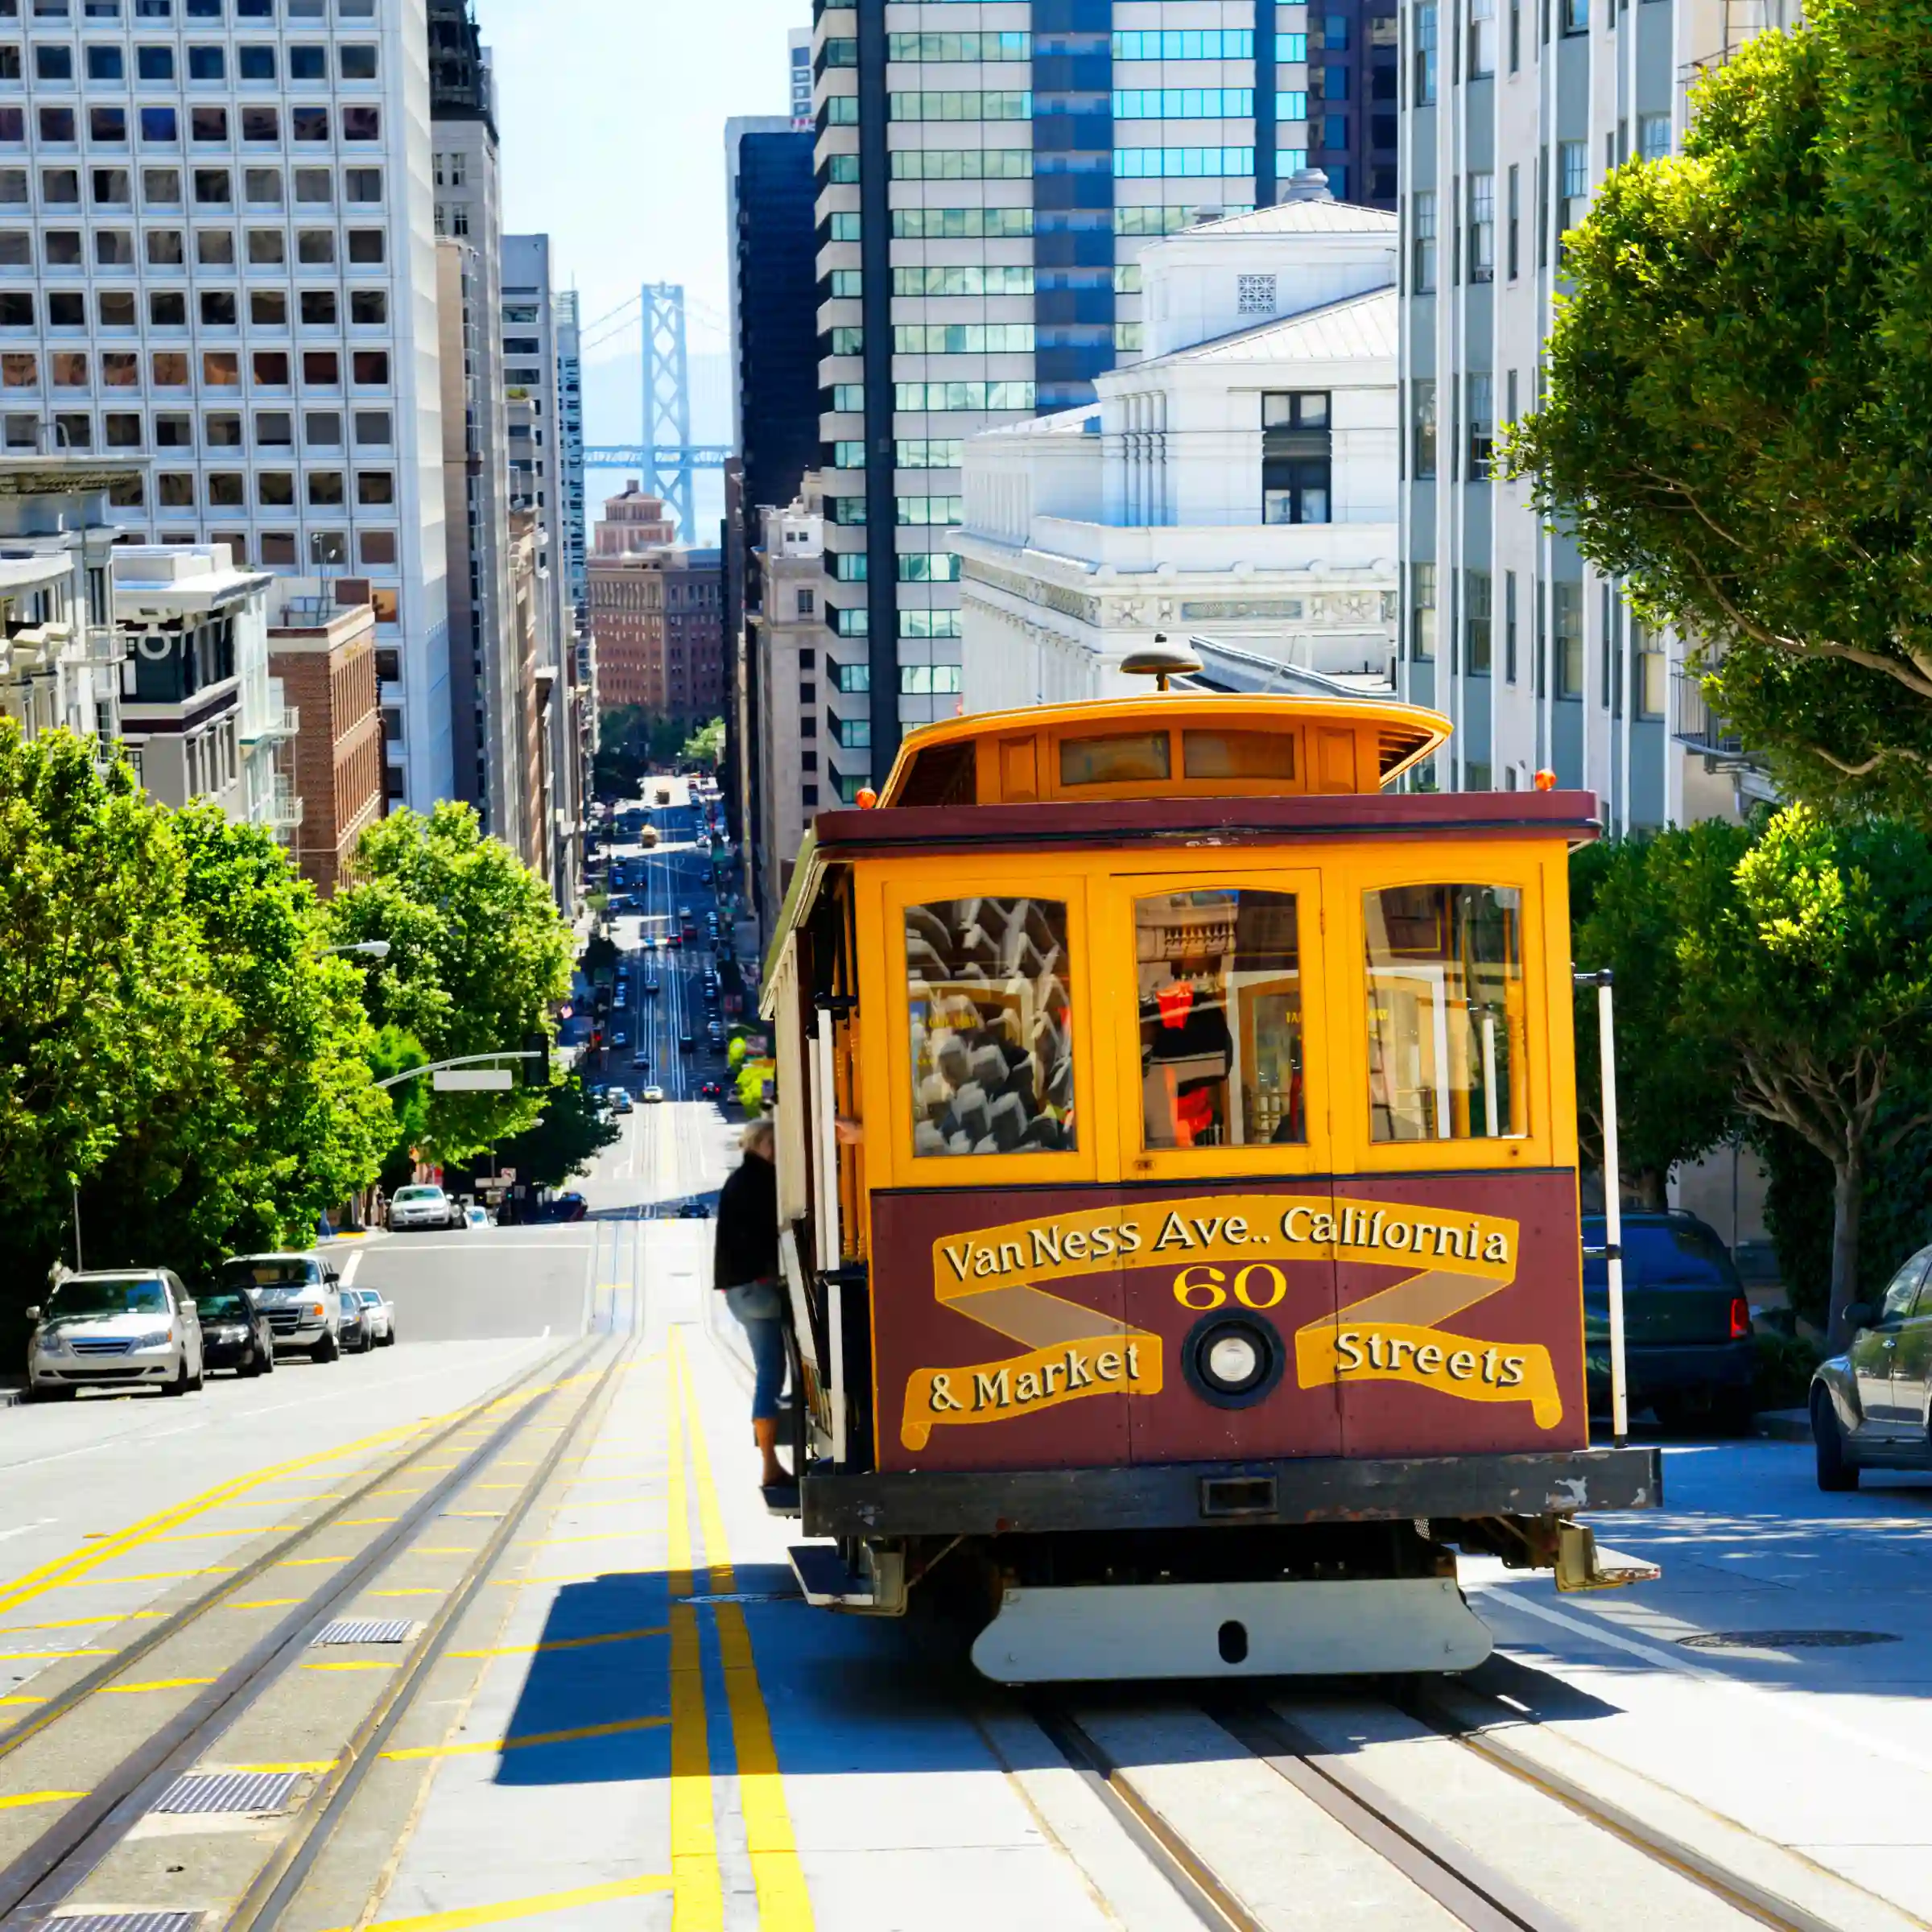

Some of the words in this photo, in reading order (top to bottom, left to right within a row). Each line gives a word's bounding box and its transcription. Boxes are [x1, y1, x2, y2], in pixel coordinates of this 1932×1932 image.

[943, 1241, 1026, 1282] Van
[1028, 1223, 1142, 1266] Ness
[1281, 1206, 1509, 1264] California
[1173, 1263, 1287, 1310] 60
[929, 1373, 964, 1411] &
[970, 1342, 1141, 1411] Market
[1334, 1331, 1526, 1389] Streets
